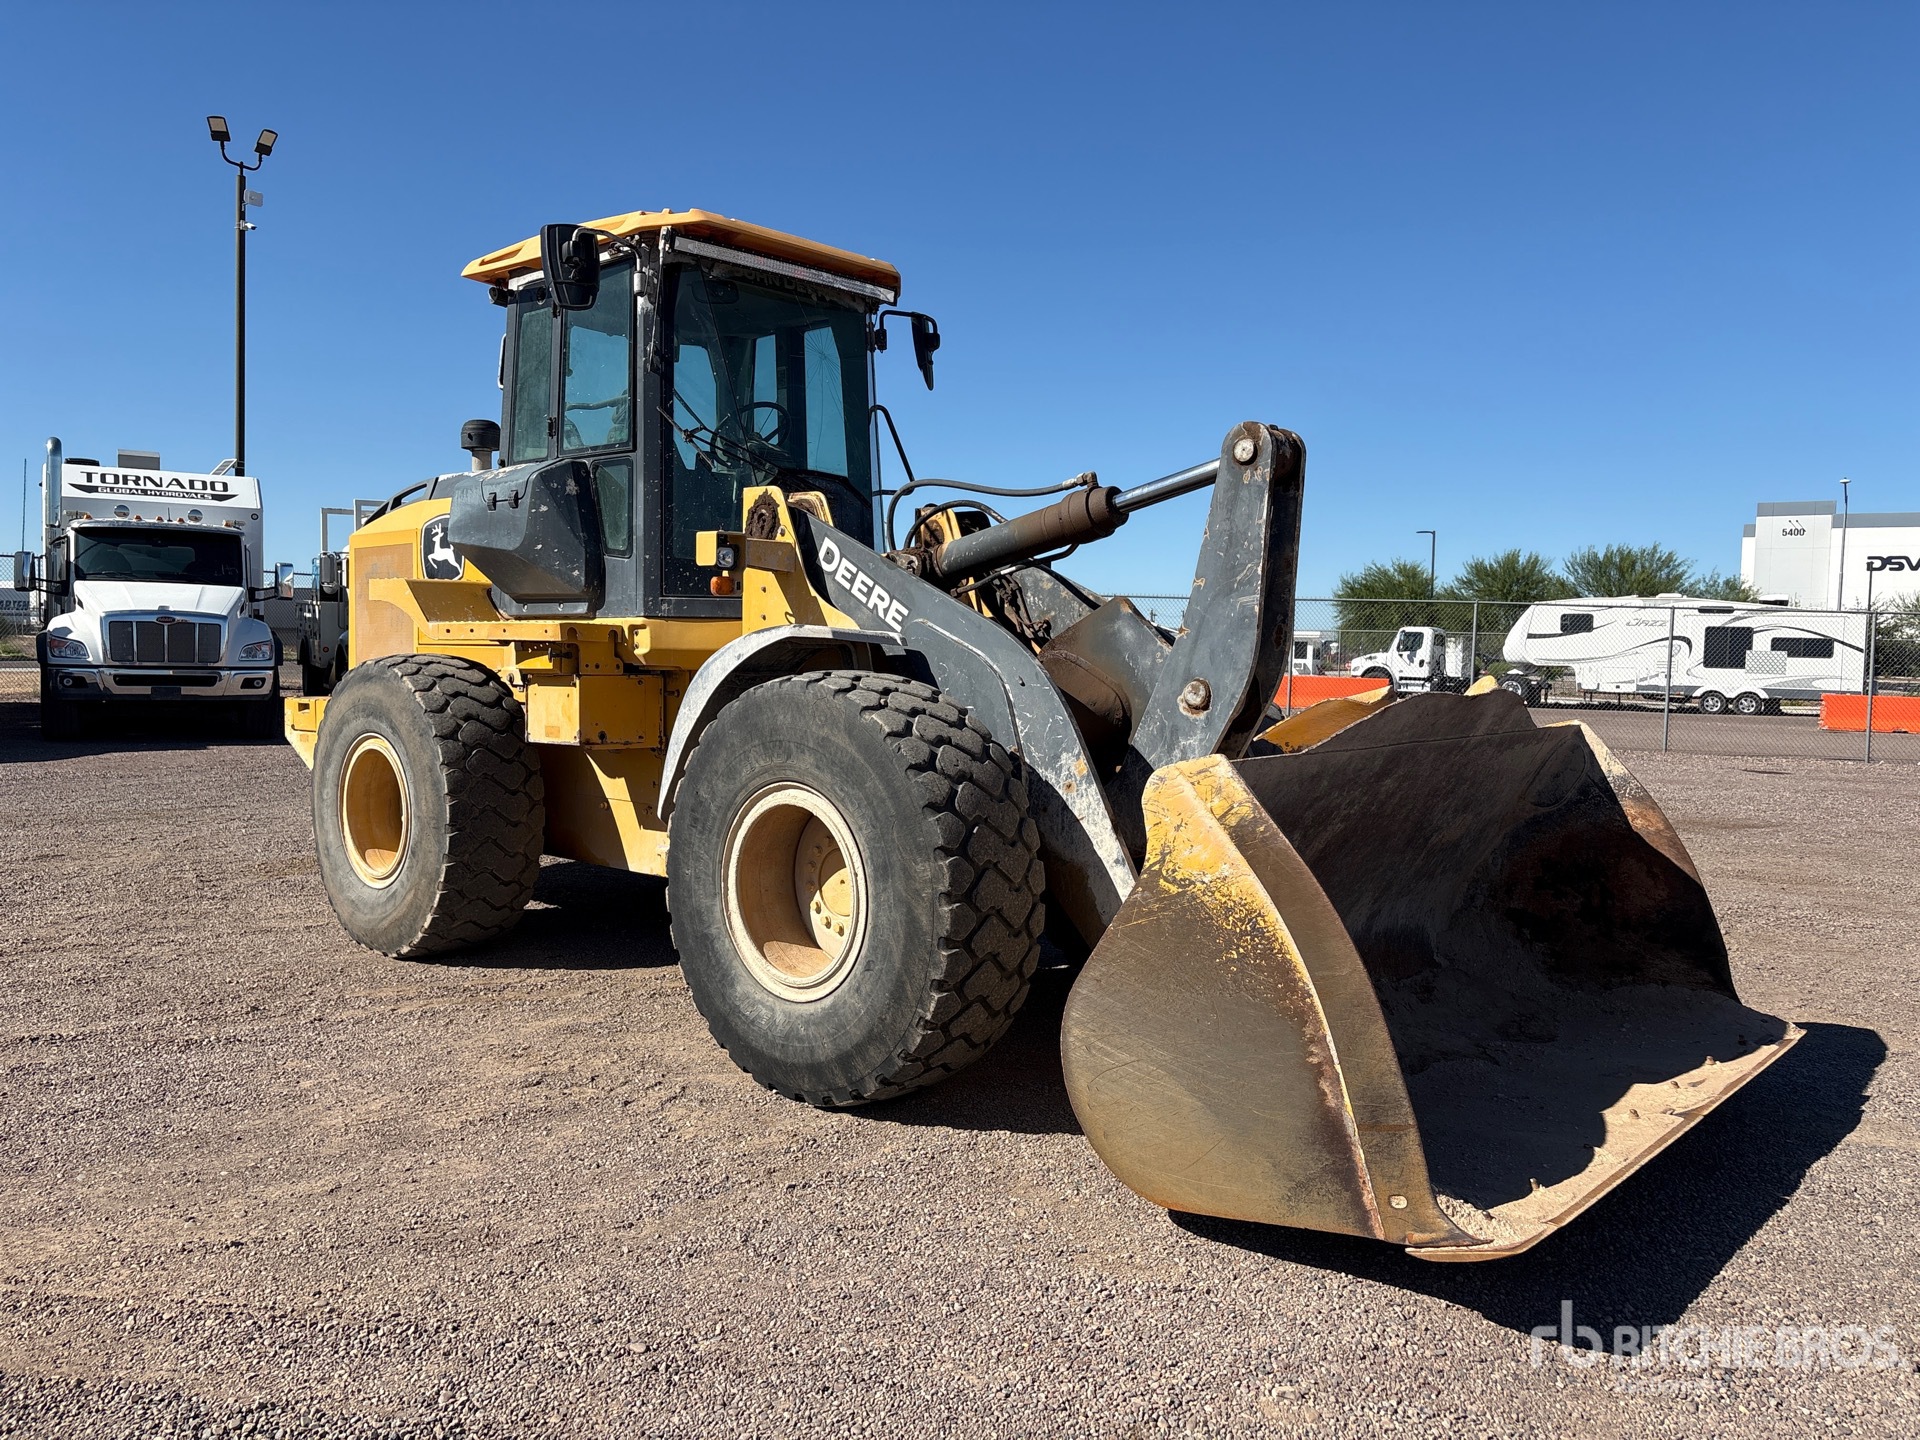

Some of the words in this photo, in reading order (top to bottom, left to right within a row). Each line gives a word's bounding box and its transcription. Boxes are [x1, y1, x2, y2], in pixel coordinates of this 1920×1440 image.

[80, 471, 229, 493] TORNADO
[98, 486, 145, 495] GLOBAL
[147, 489, 213, 500] HYDROVACS
[1781, 528, 1806, 537] 5400
[1866, 555, 1920, 571] DSV
[818, 536, 910, 633] DEERE
